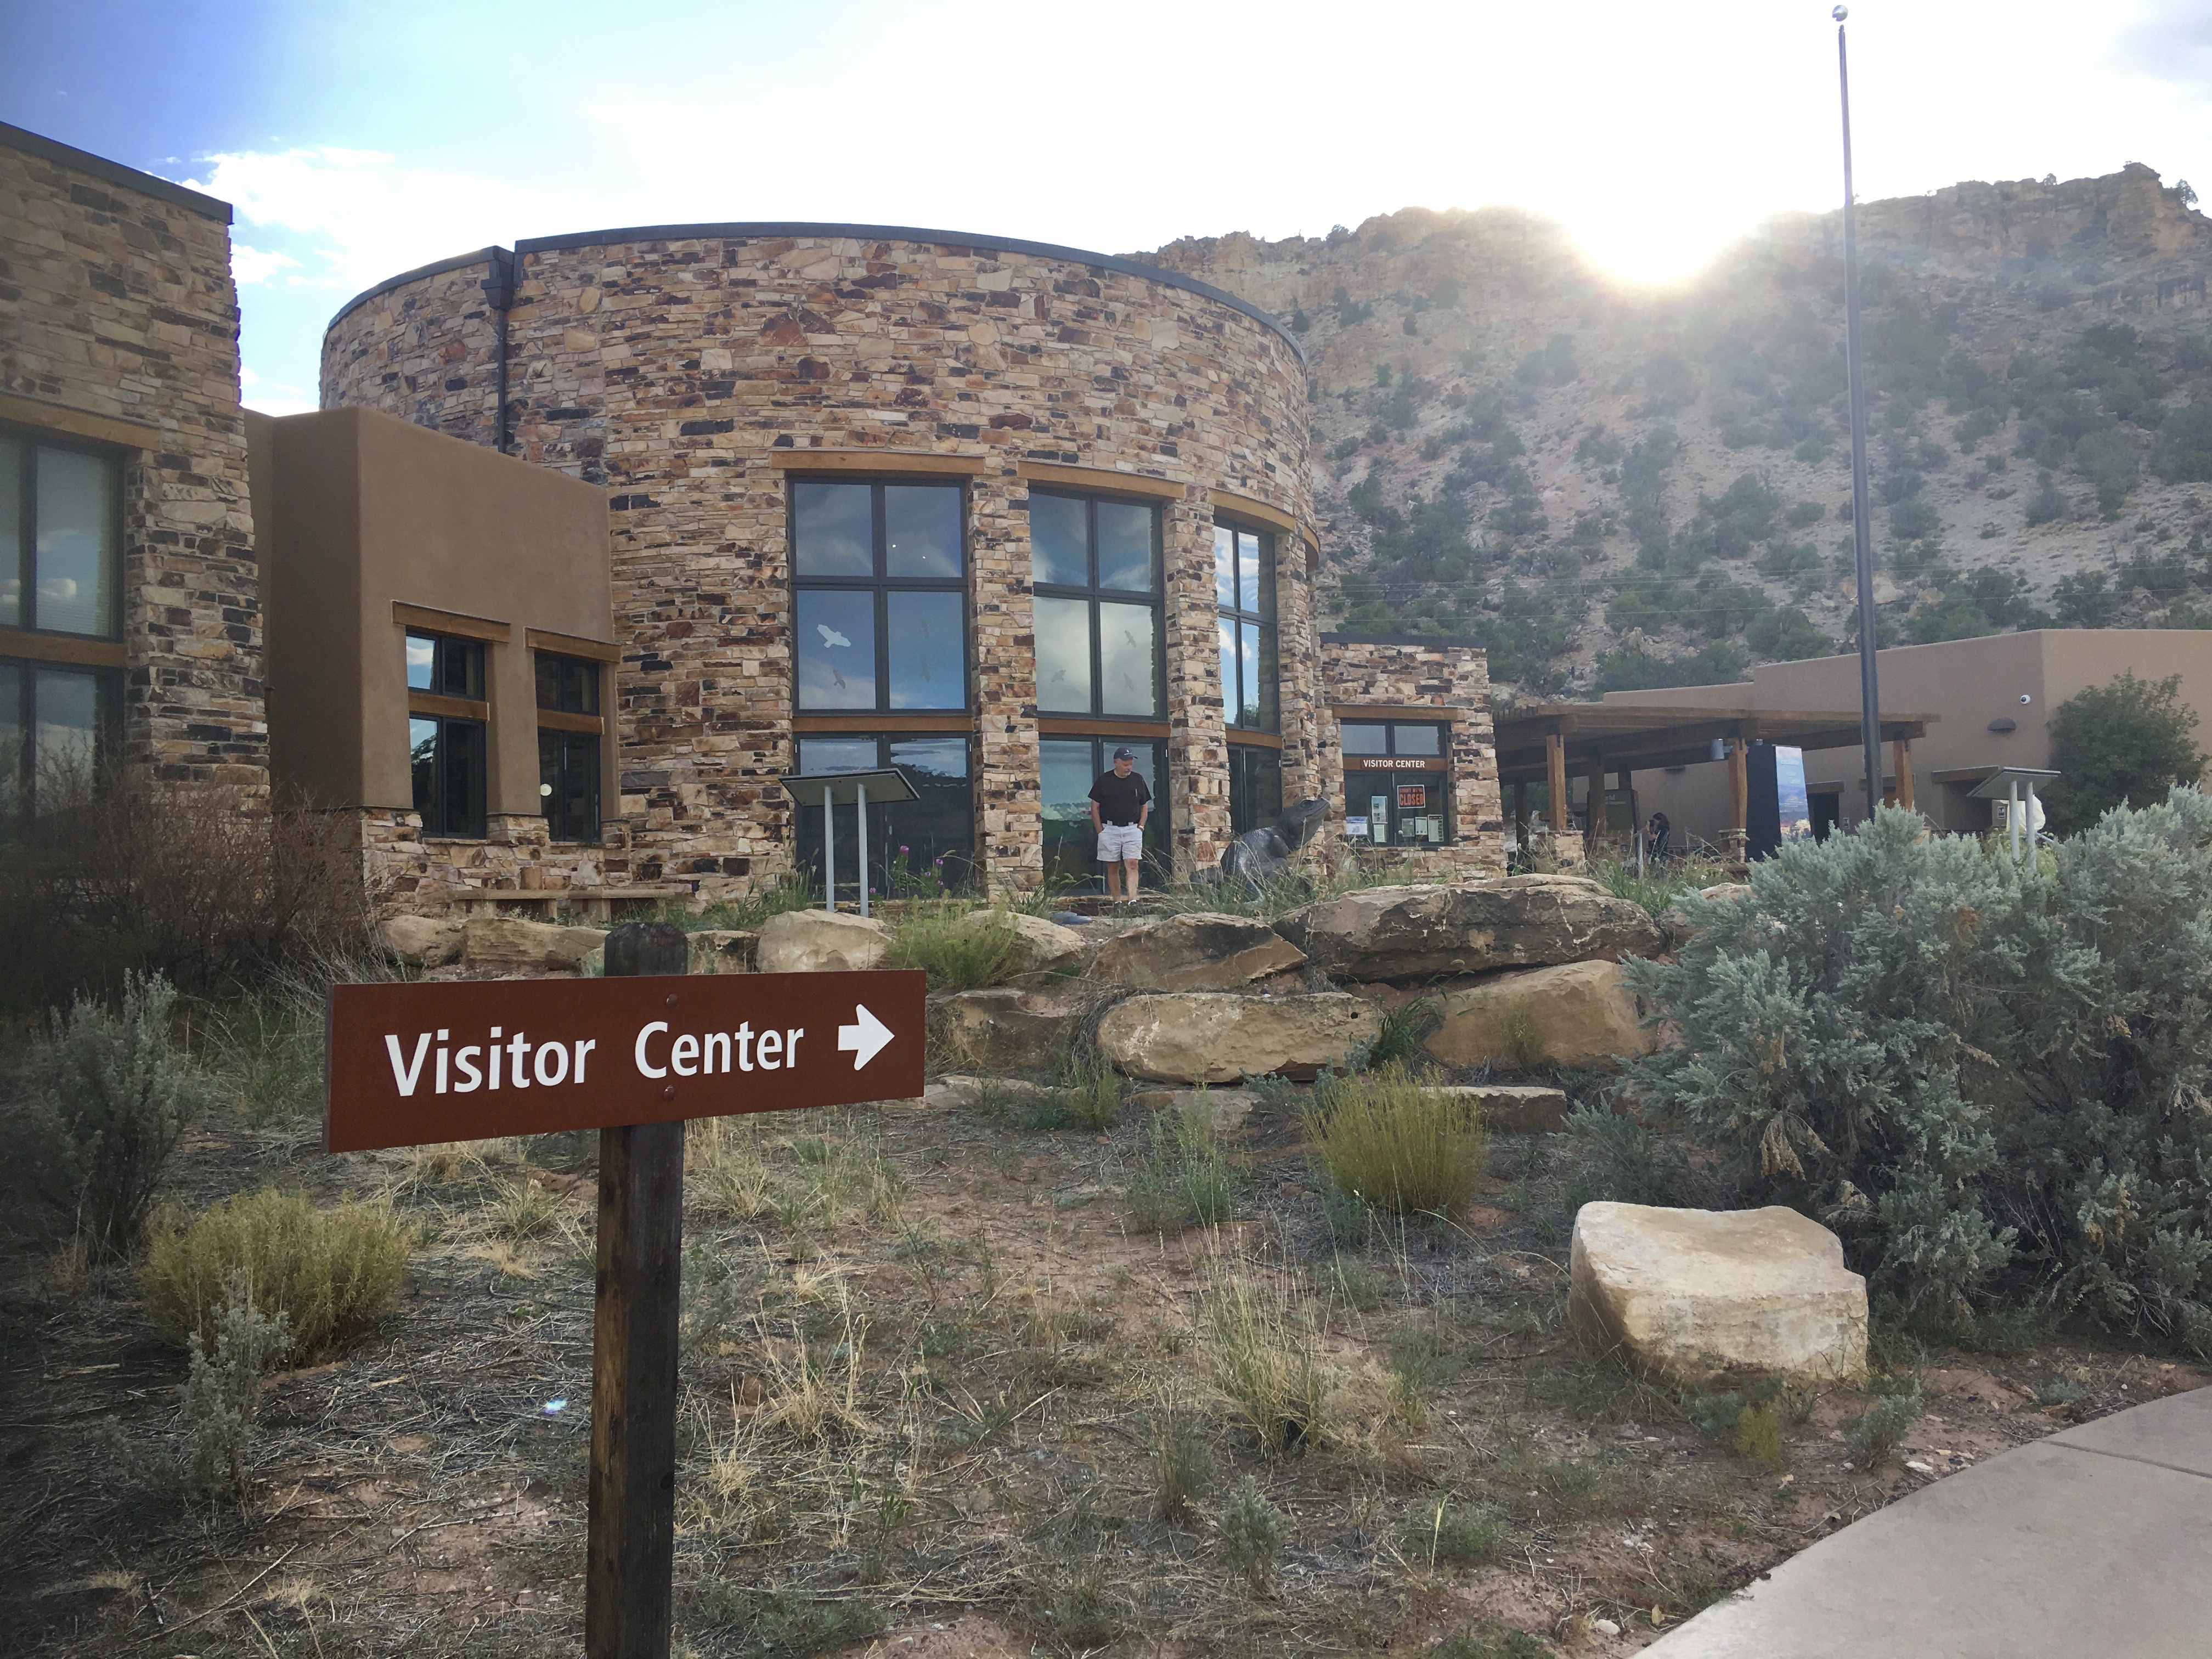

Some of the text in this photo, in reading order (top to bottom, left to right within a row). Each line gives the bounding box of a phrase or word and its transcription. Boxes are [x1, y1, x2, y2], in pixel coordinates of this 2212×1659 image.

[1363, 759, 1425, 768] VISITOR CENTER
[1400, 794, 1423, 805] CLOSED
[384, 1020, 804, 1097] Visitor Center
